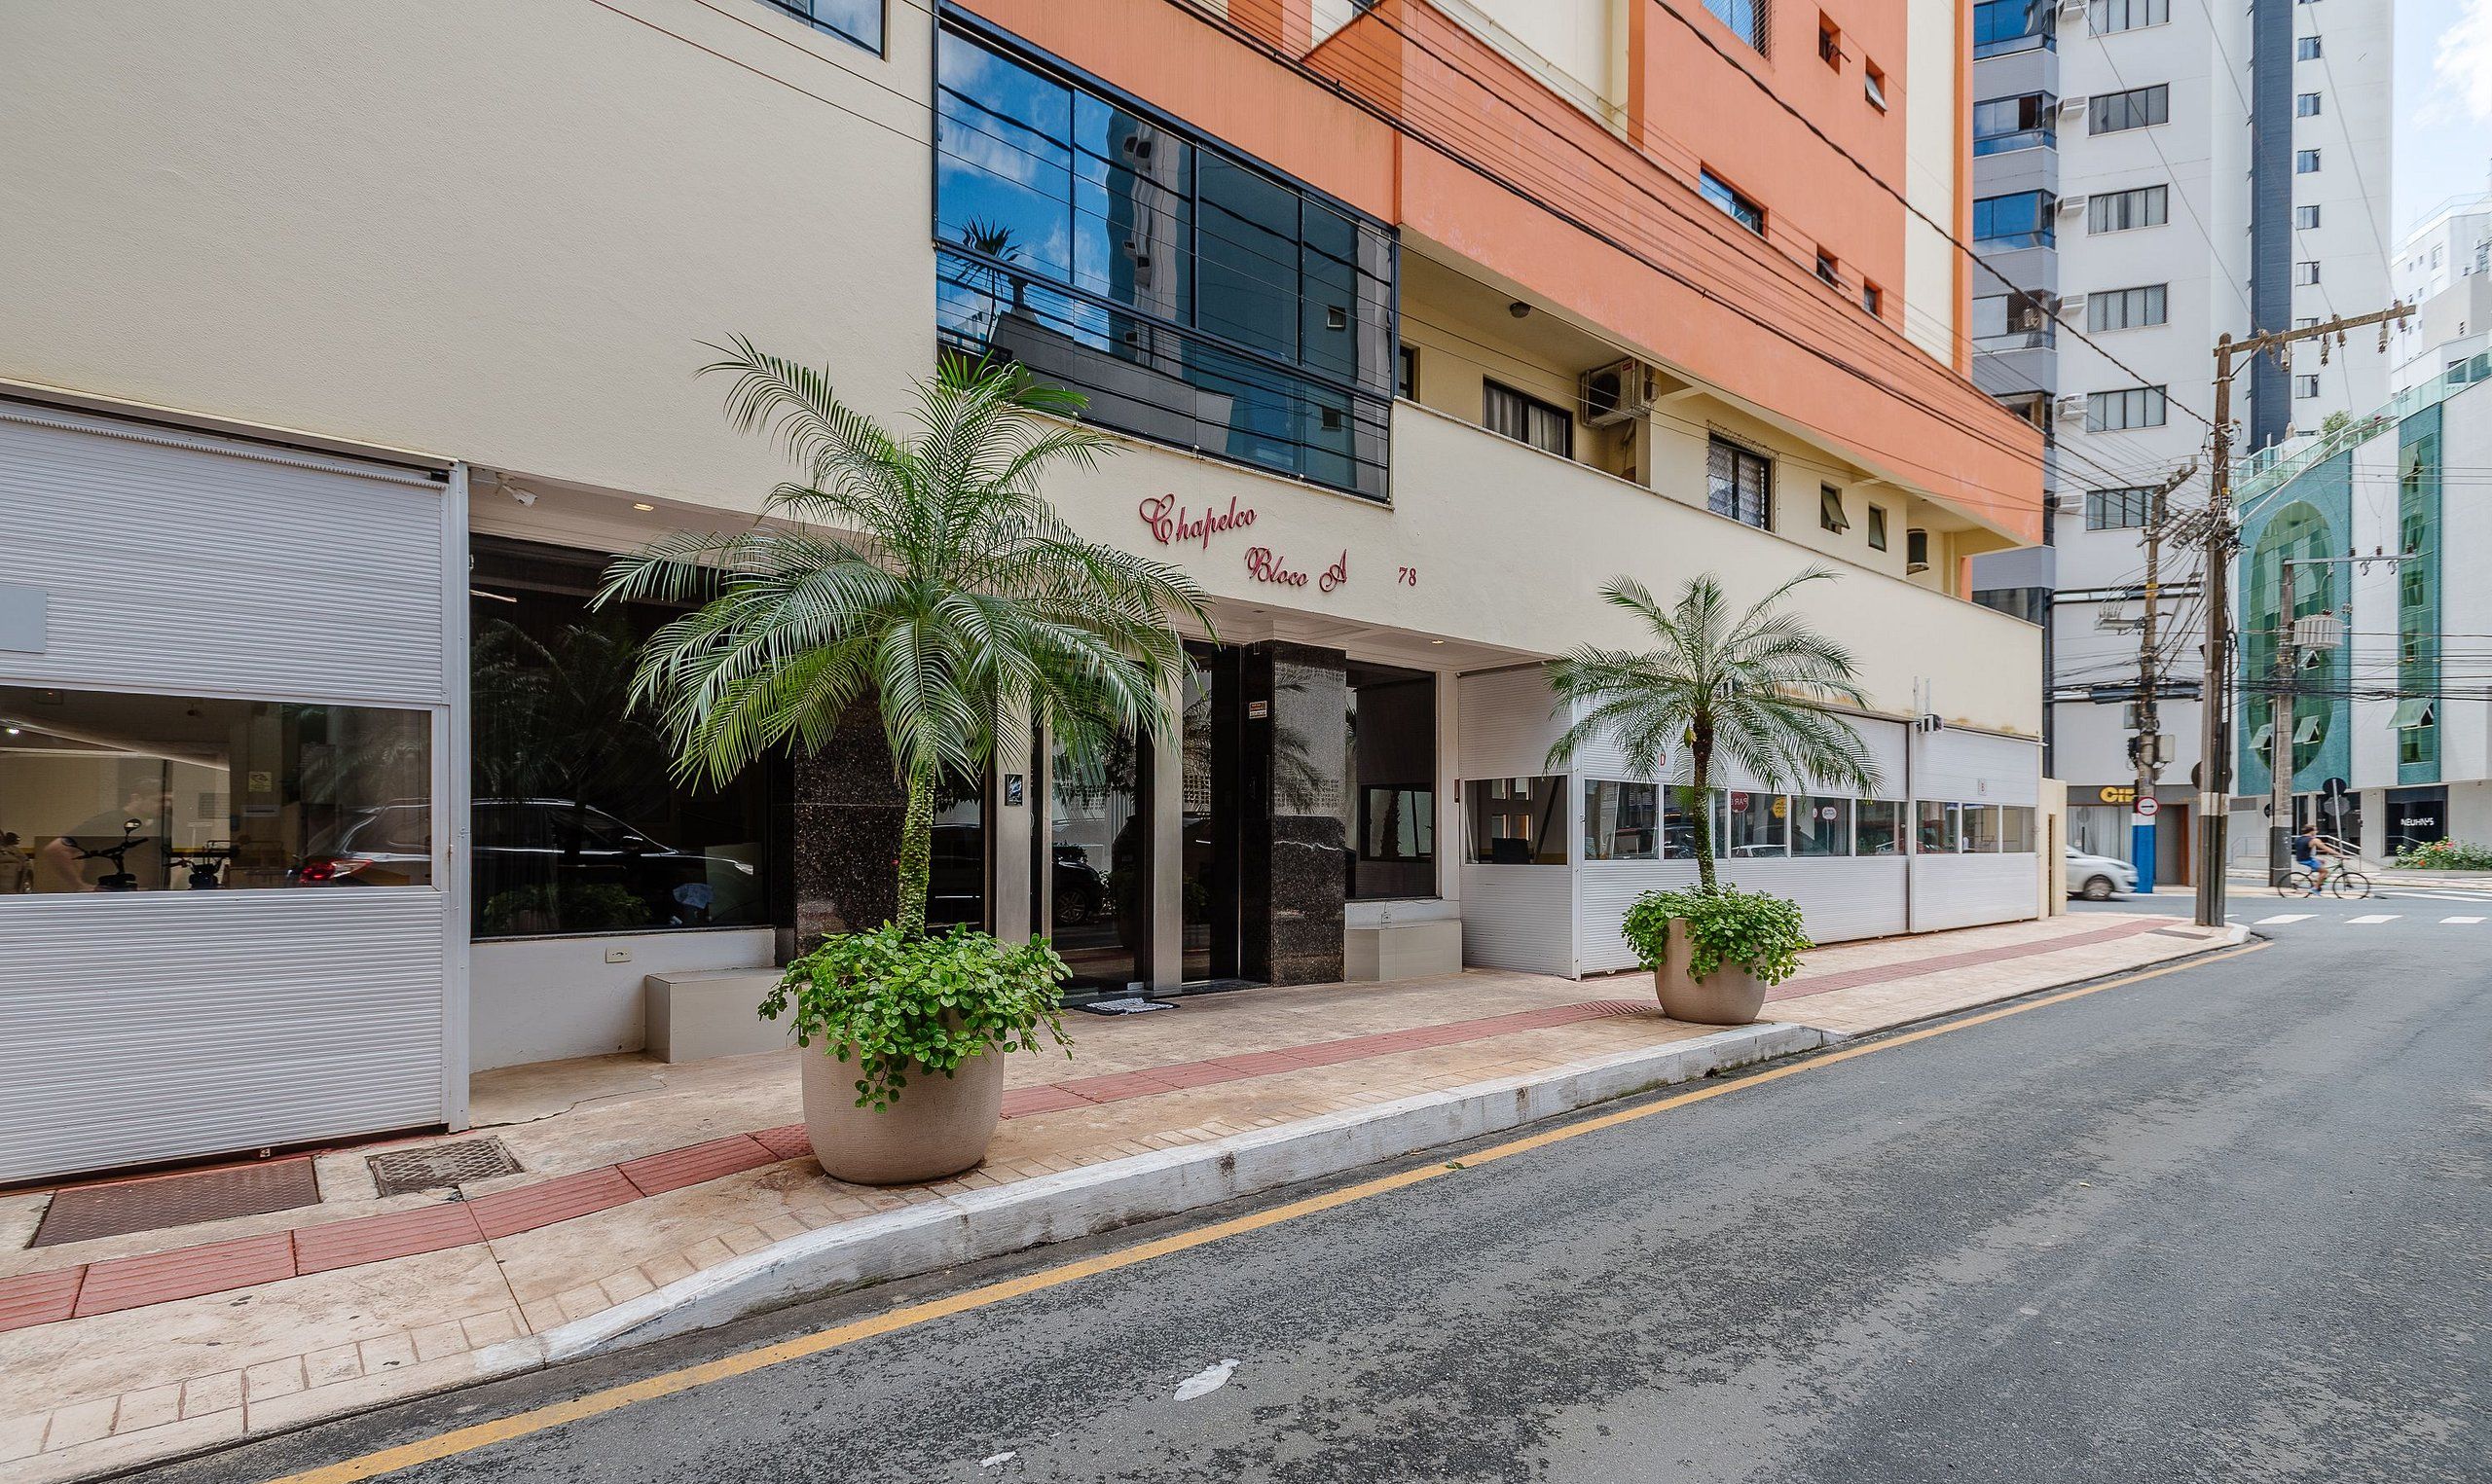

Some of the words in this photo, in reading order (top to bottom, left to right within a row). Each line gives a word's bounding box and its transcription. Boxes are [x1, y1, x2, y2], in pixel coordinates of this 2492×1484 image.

[1139, 493, 1257, 549] Chapelco
[1244, 547, 1309, 587] Bloco
[1319, 549, 1347, 592] A
[1398, 566, 1417, 587] 78
